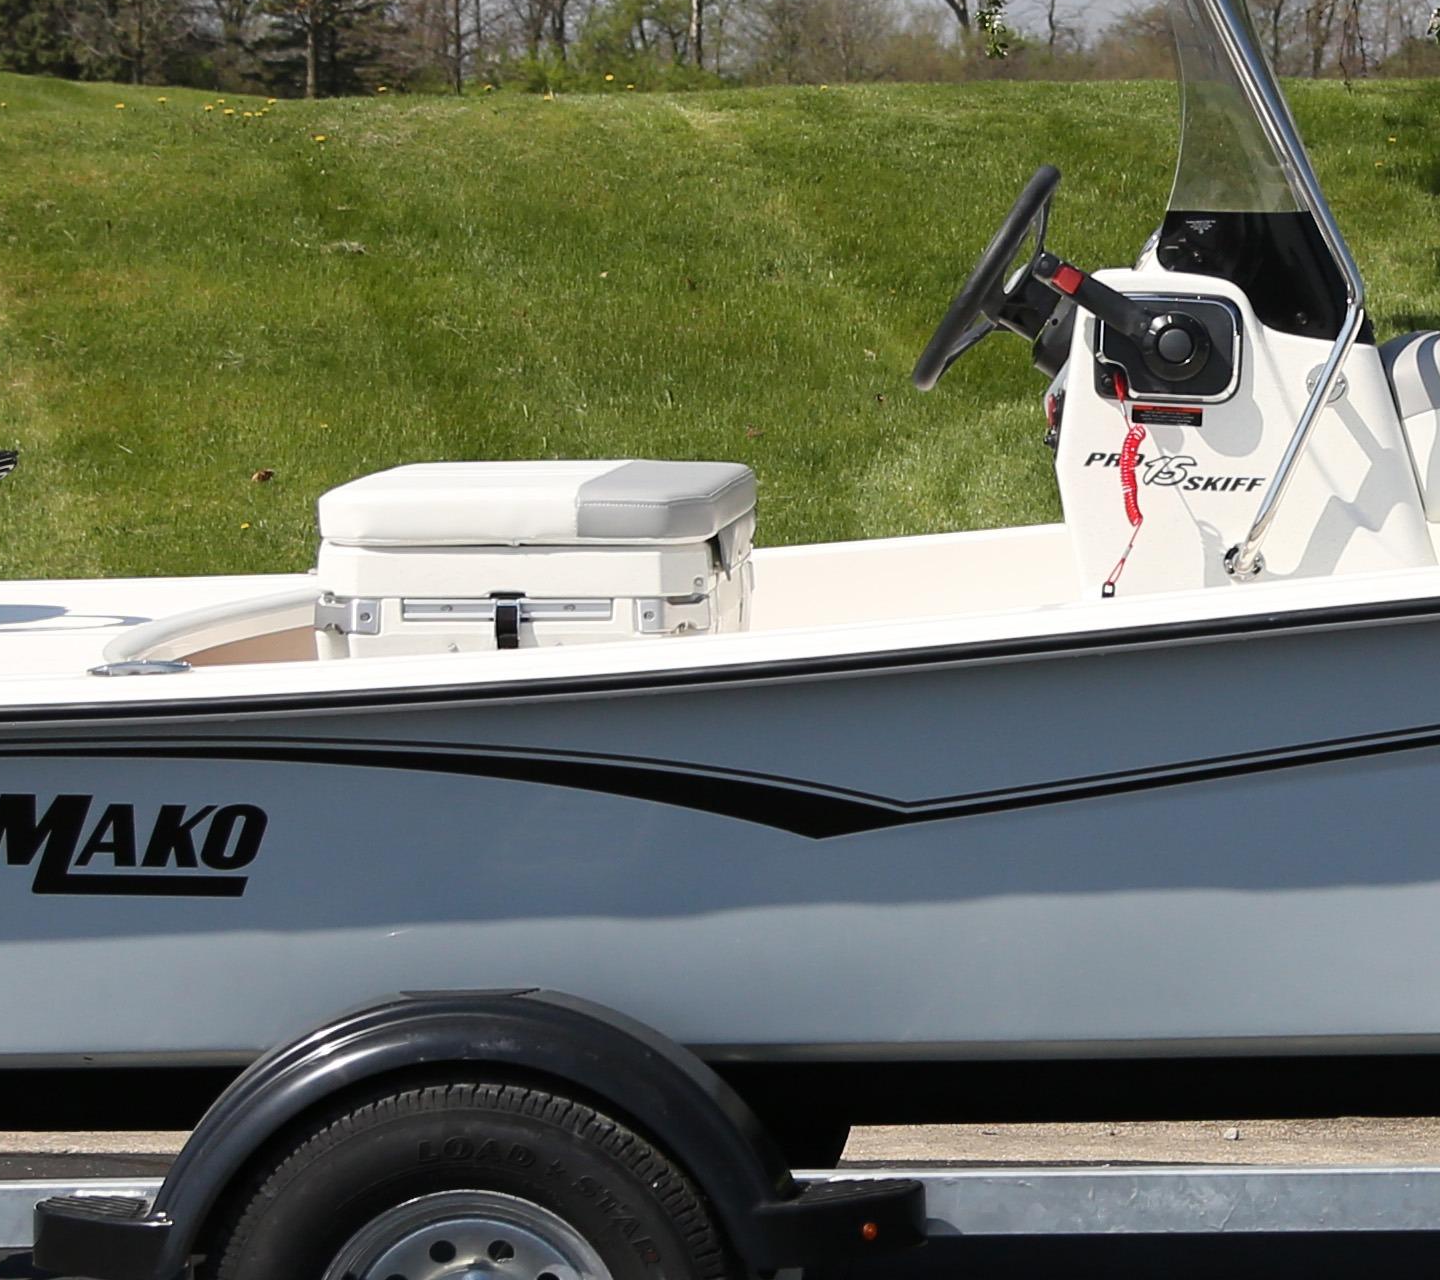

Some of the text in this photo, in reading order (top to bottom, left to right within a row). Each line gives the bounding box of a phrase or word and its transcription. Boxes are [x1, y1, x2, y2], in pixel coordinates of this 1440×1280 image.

[1144, 455, 1197, 486] 15
[1184, 477, 1265, 492] SKIFF
[417, 1134, 661, 1267] LOAD STAR
